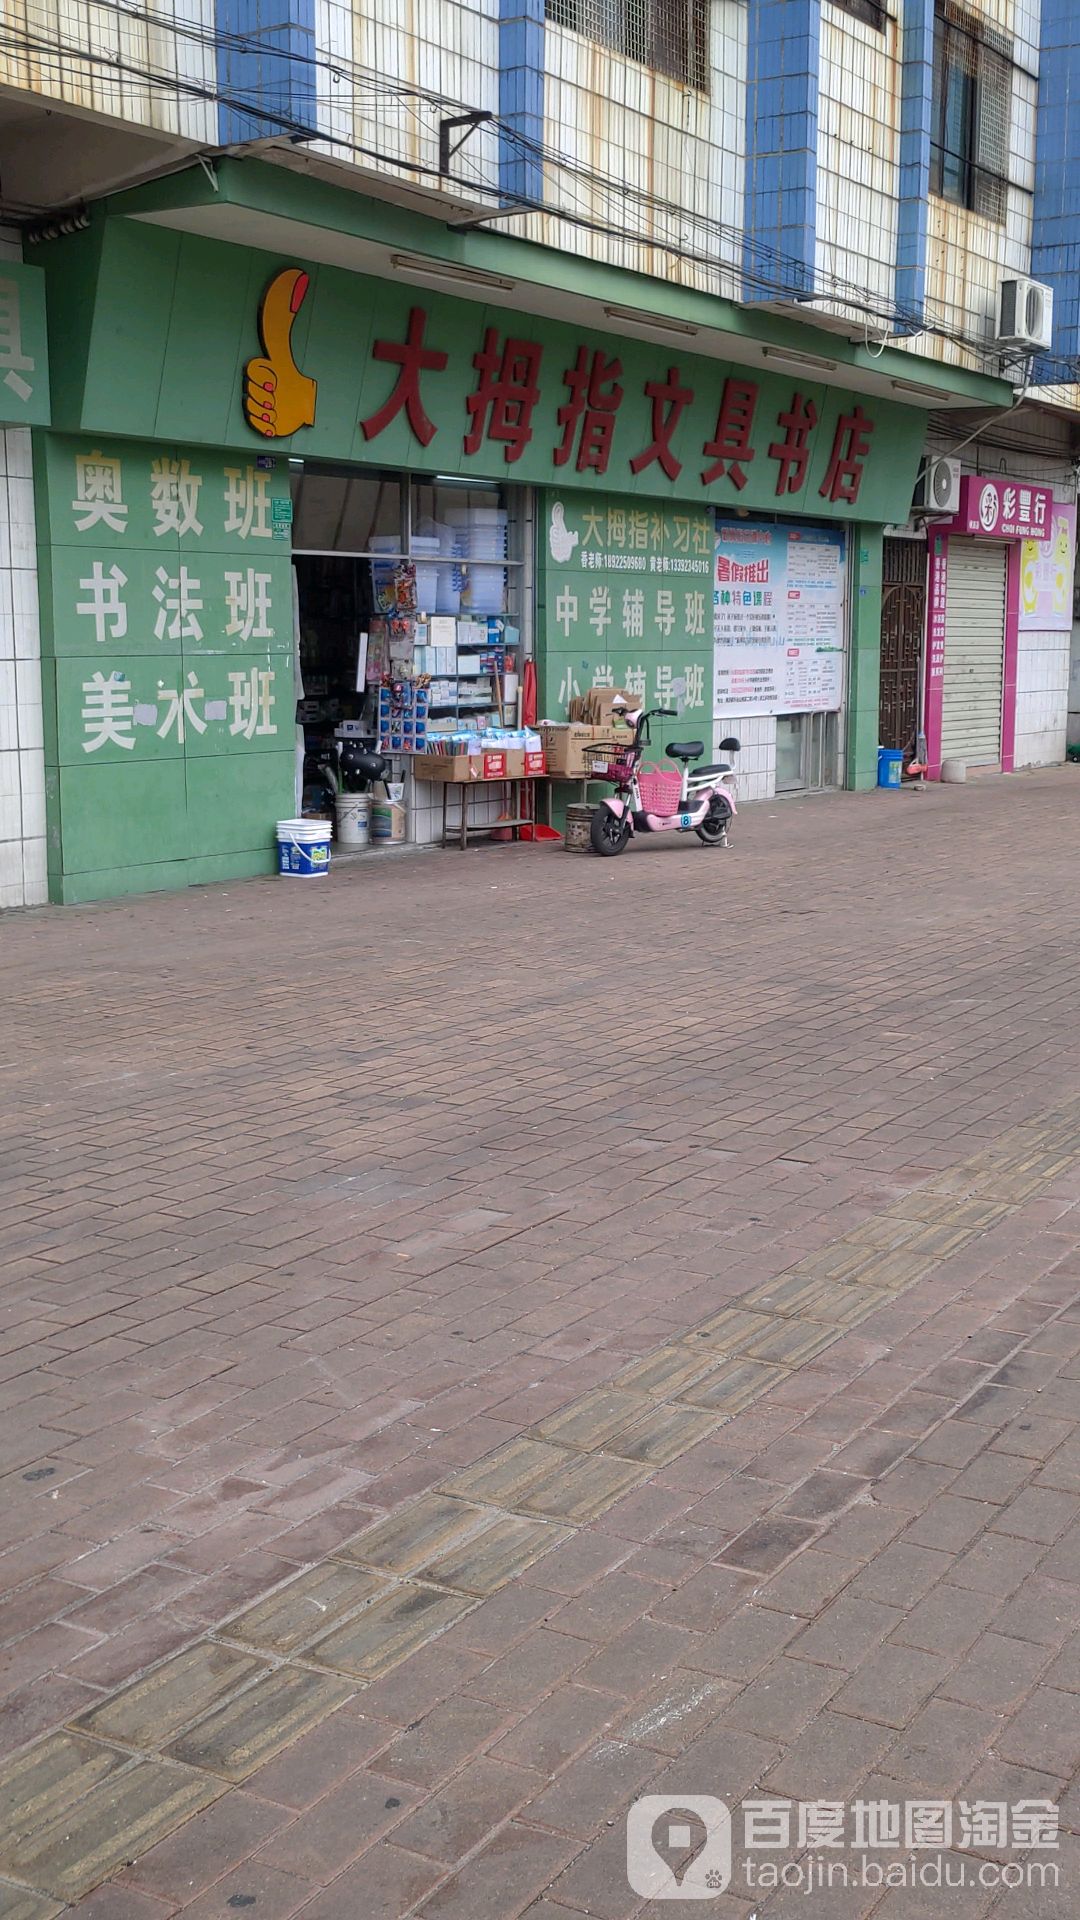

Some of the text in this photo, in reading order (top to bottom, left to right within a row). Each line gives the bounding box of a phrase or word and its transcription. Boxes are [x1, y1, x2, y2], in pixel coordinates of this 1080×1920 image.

[360, 306, 875, 505] 大拇指文具书店
[72, 450, 273, 540] 奥数班
[581, 506, 711, 554] 大拇指补习社
[76, 561, 274, 642] 书法班
[717, 556, 769, 583] 暑假推出
[556, 585, 705, 637] 中学辅导班
[82, 666, 277, 753] 美术班
